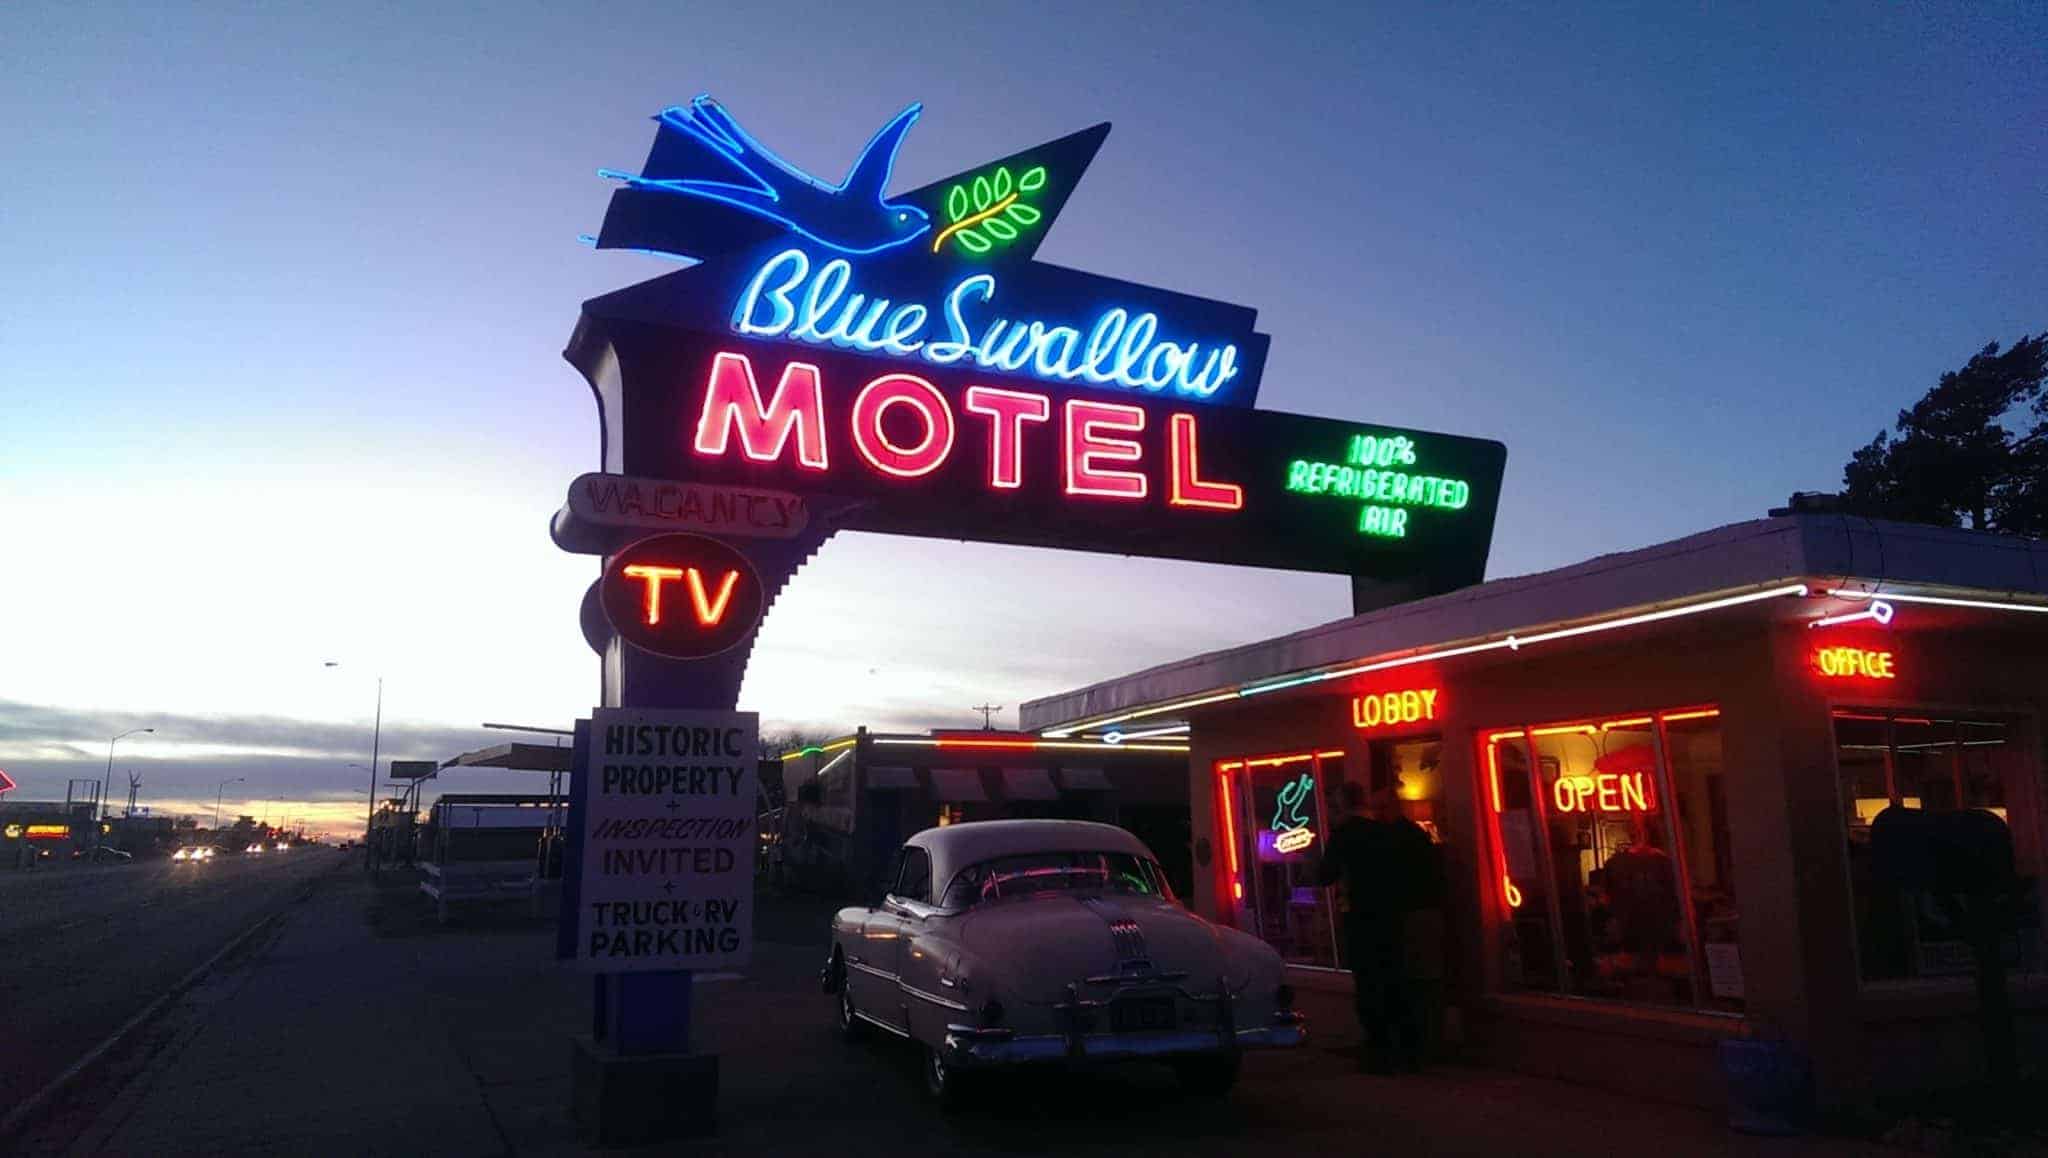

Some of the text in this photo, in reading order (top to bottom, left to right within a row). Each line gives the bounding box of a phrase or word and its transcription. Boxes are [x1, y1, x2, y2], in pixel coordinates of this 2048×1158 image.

[732, 248, 1238, 399] Blue Swallow
[694, 351, 1243, 509] MOTEL
[1349, 434, 1417, 467] 100%
[1286, 460, 1470, 510] REFRIGERATED
[1359, 505, 1408, 537] AIR
[622, 563, 741, 625] TV
[1818, 646, 1896, 679] OFFICE
[1352, 687, 1438, 728] LOBBY
[604, 725, 745, 757] HISTORIC
[601, 765, 745, 796] PROPERTY
[1553, 771, 1648, 813] OPEN
[592, 817, 753, 841] INSPECTION
[602, 848, 735, 876] INVITED
[590, 901, 689, 927] TRUCK
[704, 898, 740, 925] RV
[589, 928, 741, 958] PARKING
